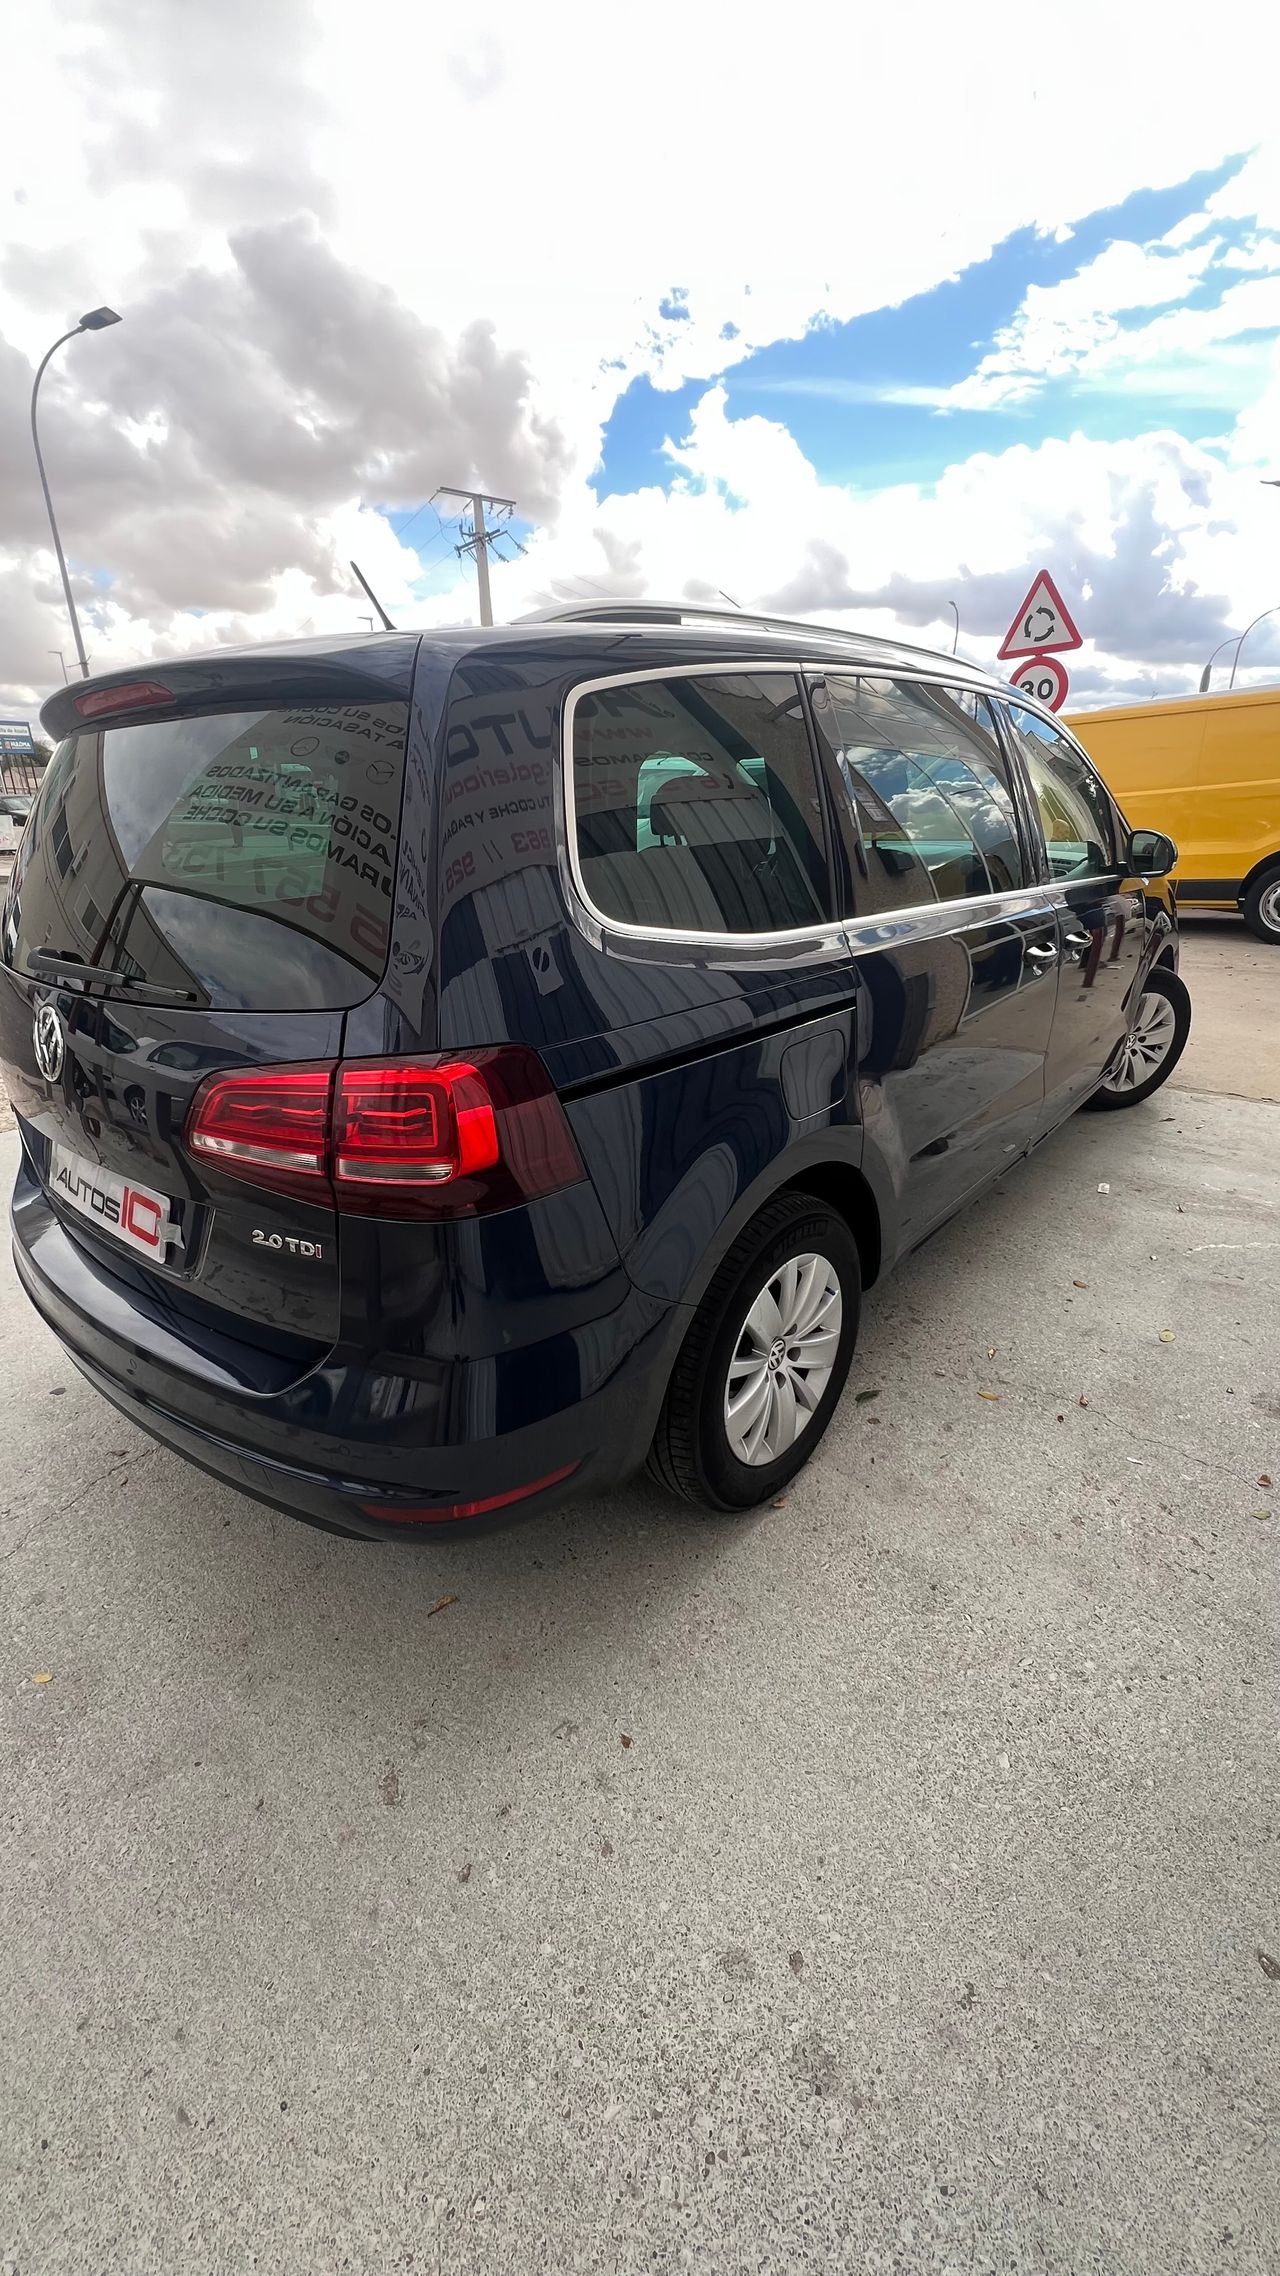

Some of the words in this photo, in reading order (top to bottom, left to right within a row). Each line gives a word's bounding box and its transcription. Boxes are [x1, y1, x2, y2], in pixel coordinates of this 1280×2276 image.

[1020, 678, 1054, 700] 30
[251, 1229, 283, 1249] 2.0
[284, 1236, 323, 1259] TDI
